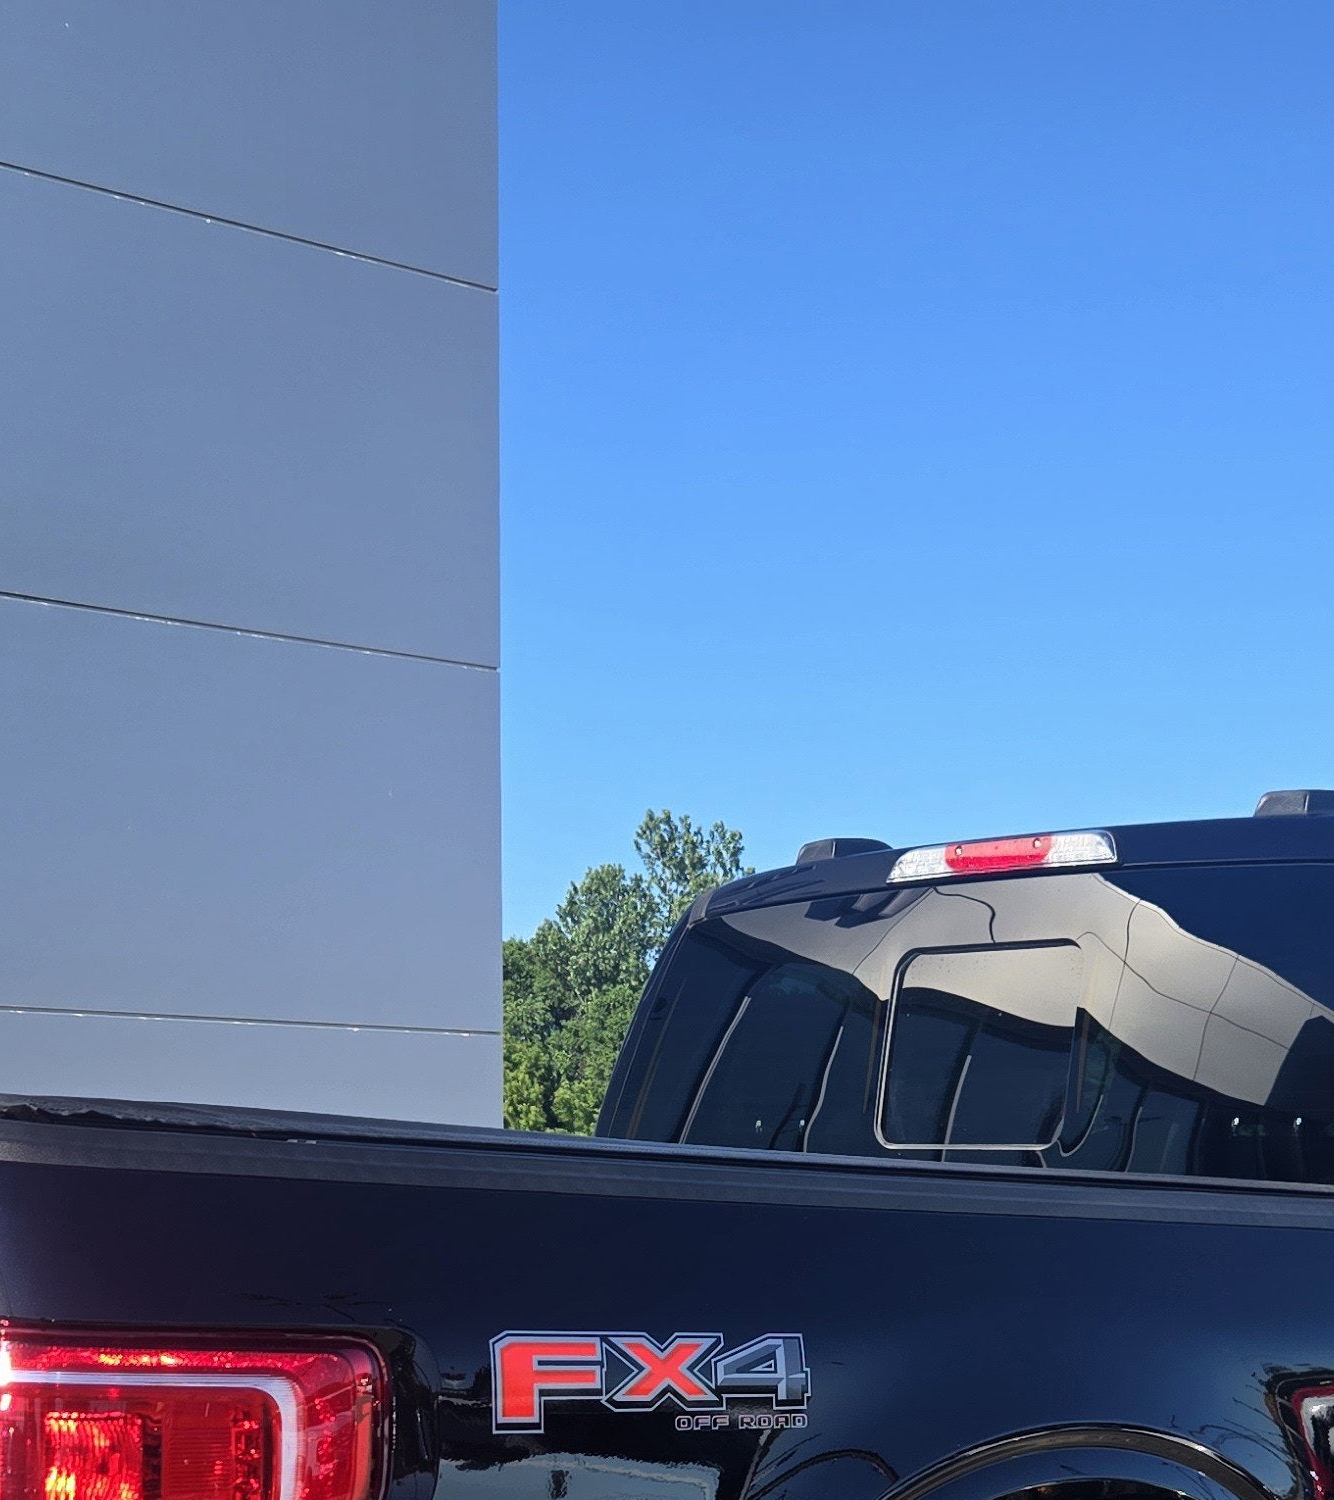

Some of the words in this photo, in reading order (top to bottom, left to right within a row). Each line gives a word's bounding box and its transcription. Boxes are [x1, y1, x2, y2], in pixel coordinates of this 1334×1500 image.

[489, 1330, 812, 1434] FX4
[675, 1414, 731, 1431] OFF
[738, 1413, 808, 1430] ROAD
